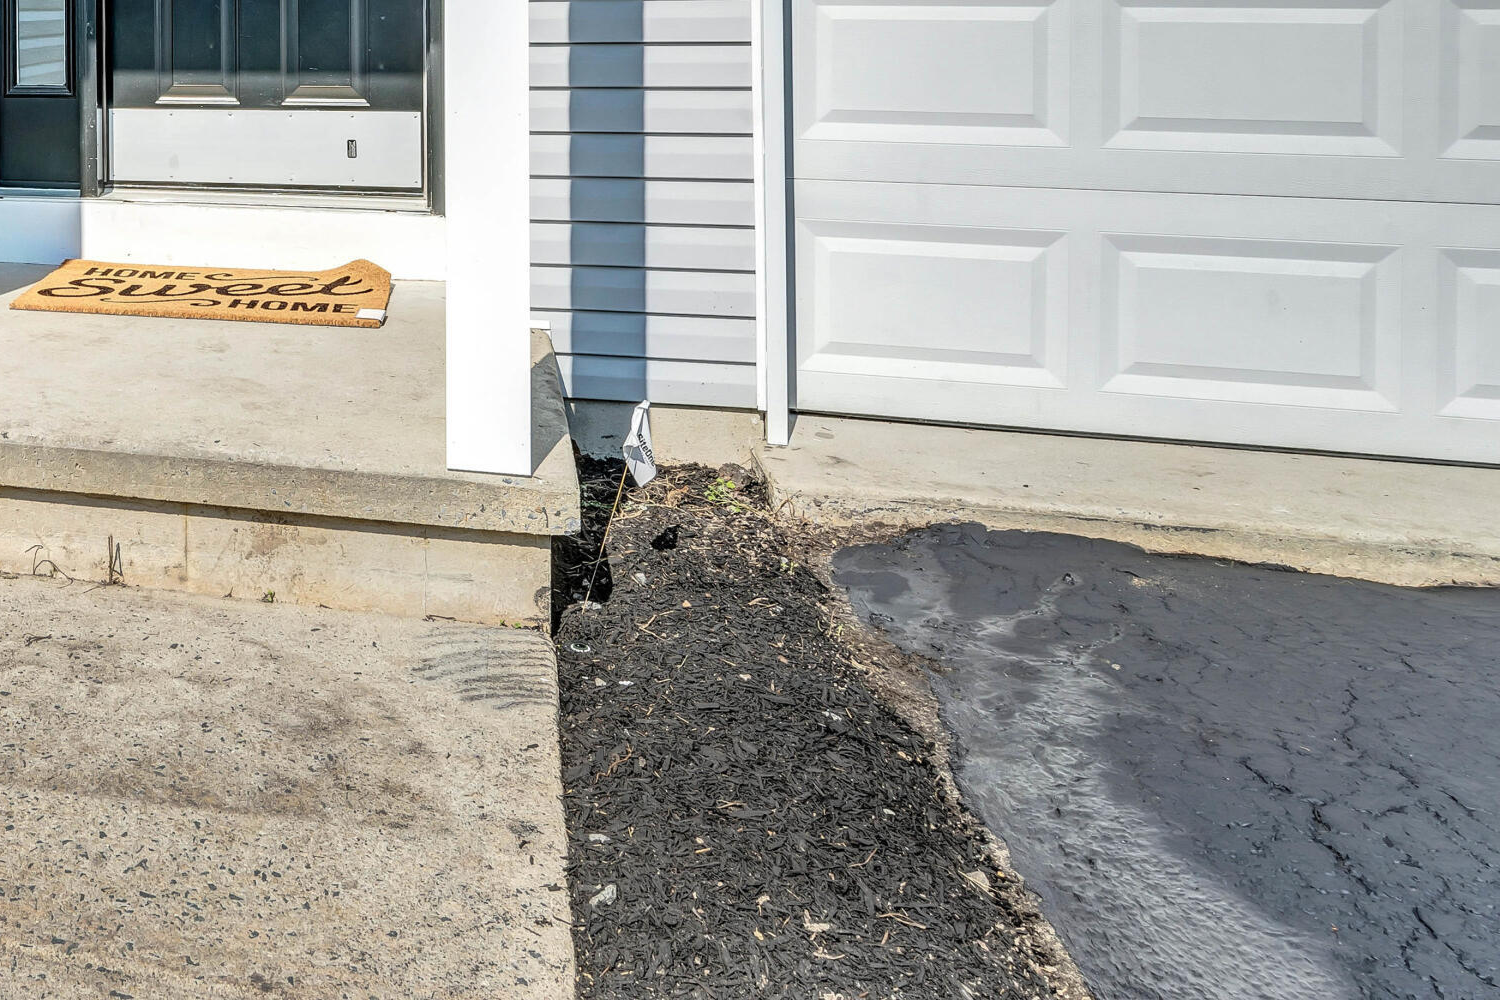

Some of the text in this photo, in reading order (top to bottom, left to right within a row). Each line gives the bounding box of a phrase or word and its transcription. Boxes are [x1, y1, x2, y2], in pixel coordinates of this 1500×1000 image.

[83, 267, 197, 281] HOME
[37, 275, 373, 298] Sweet
[227, 299, 357, 314] HOME
